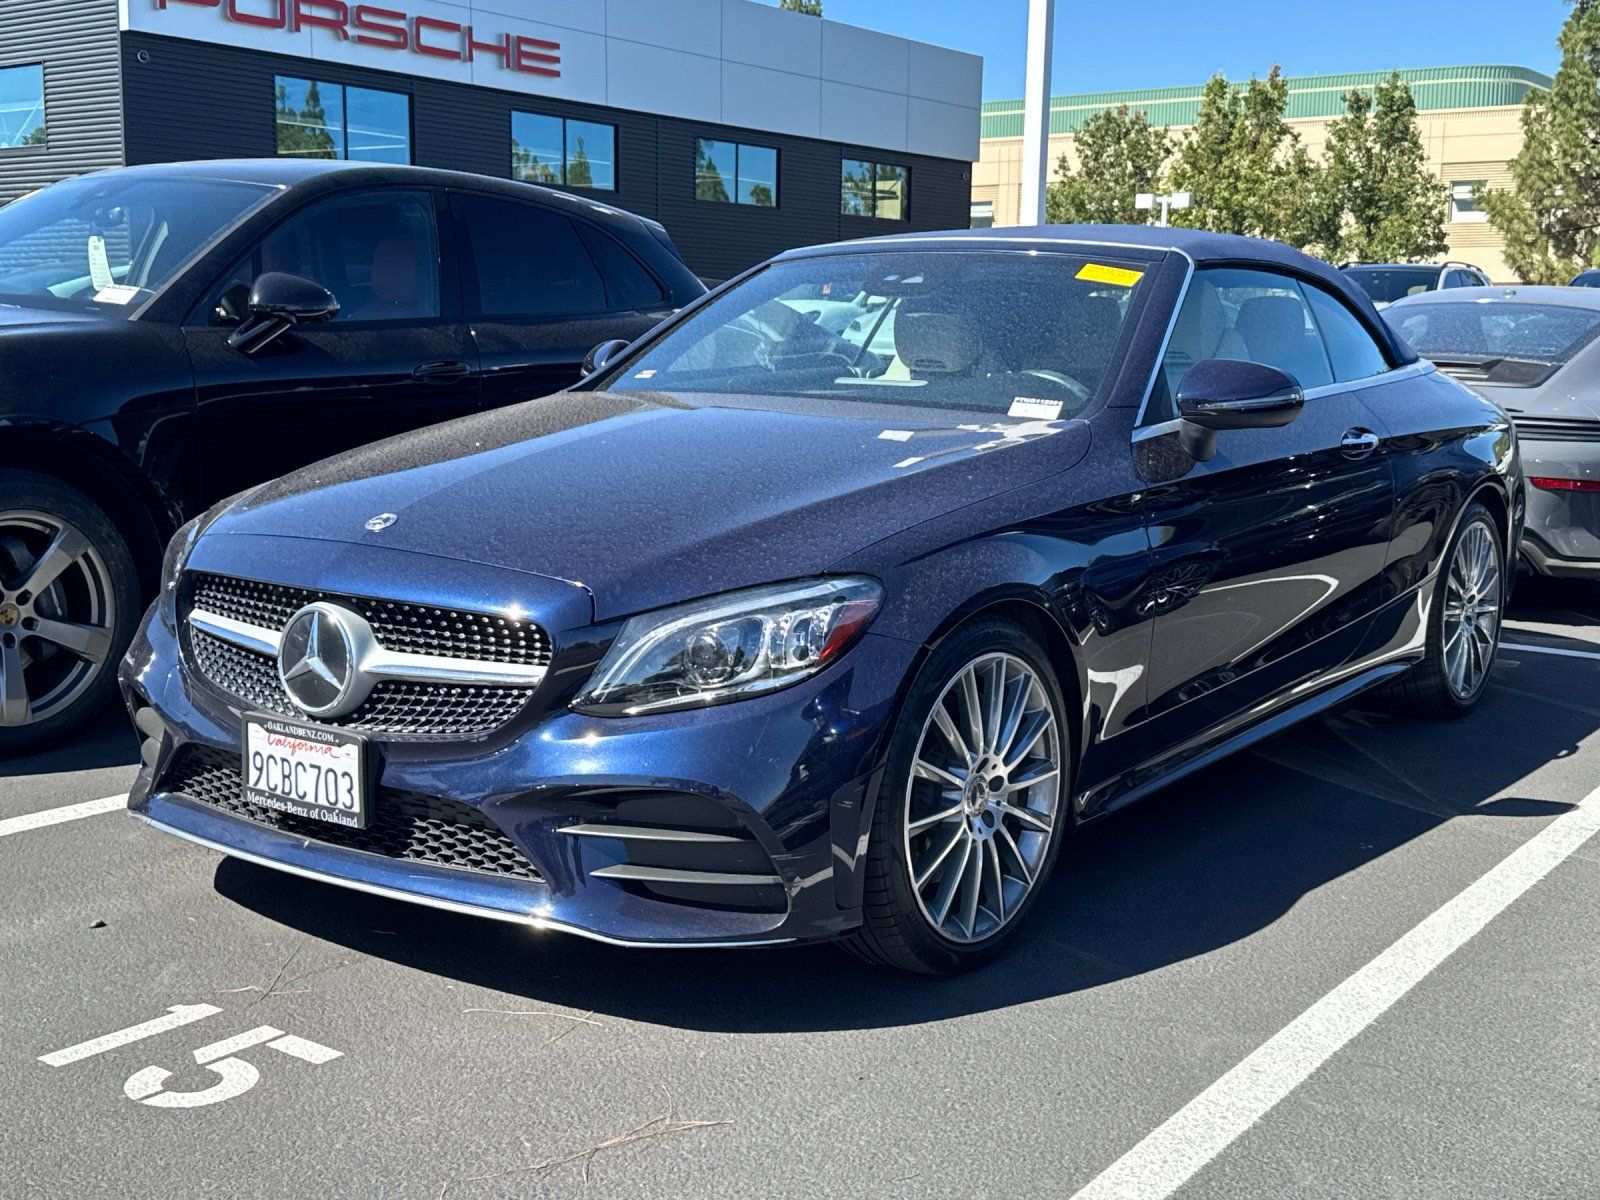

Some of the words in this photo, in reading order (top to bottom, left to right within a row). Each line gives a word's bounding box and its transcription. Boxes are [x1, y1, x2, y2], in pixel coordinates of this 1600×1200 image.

[158, 0, 560, 78] ORSCHE
[267, 721, 334, 743] OAKLANDBENZ.COM
[267, 732, 340, 758] California
[252, 750, 354, 810] 9CBC703
[246, 790, 308, 818] Mercedes-Benz
[309, 808, 320, 820] of
[320, 811, 358, 828] Oakland
[36, 1002, 345, 1108] 15
